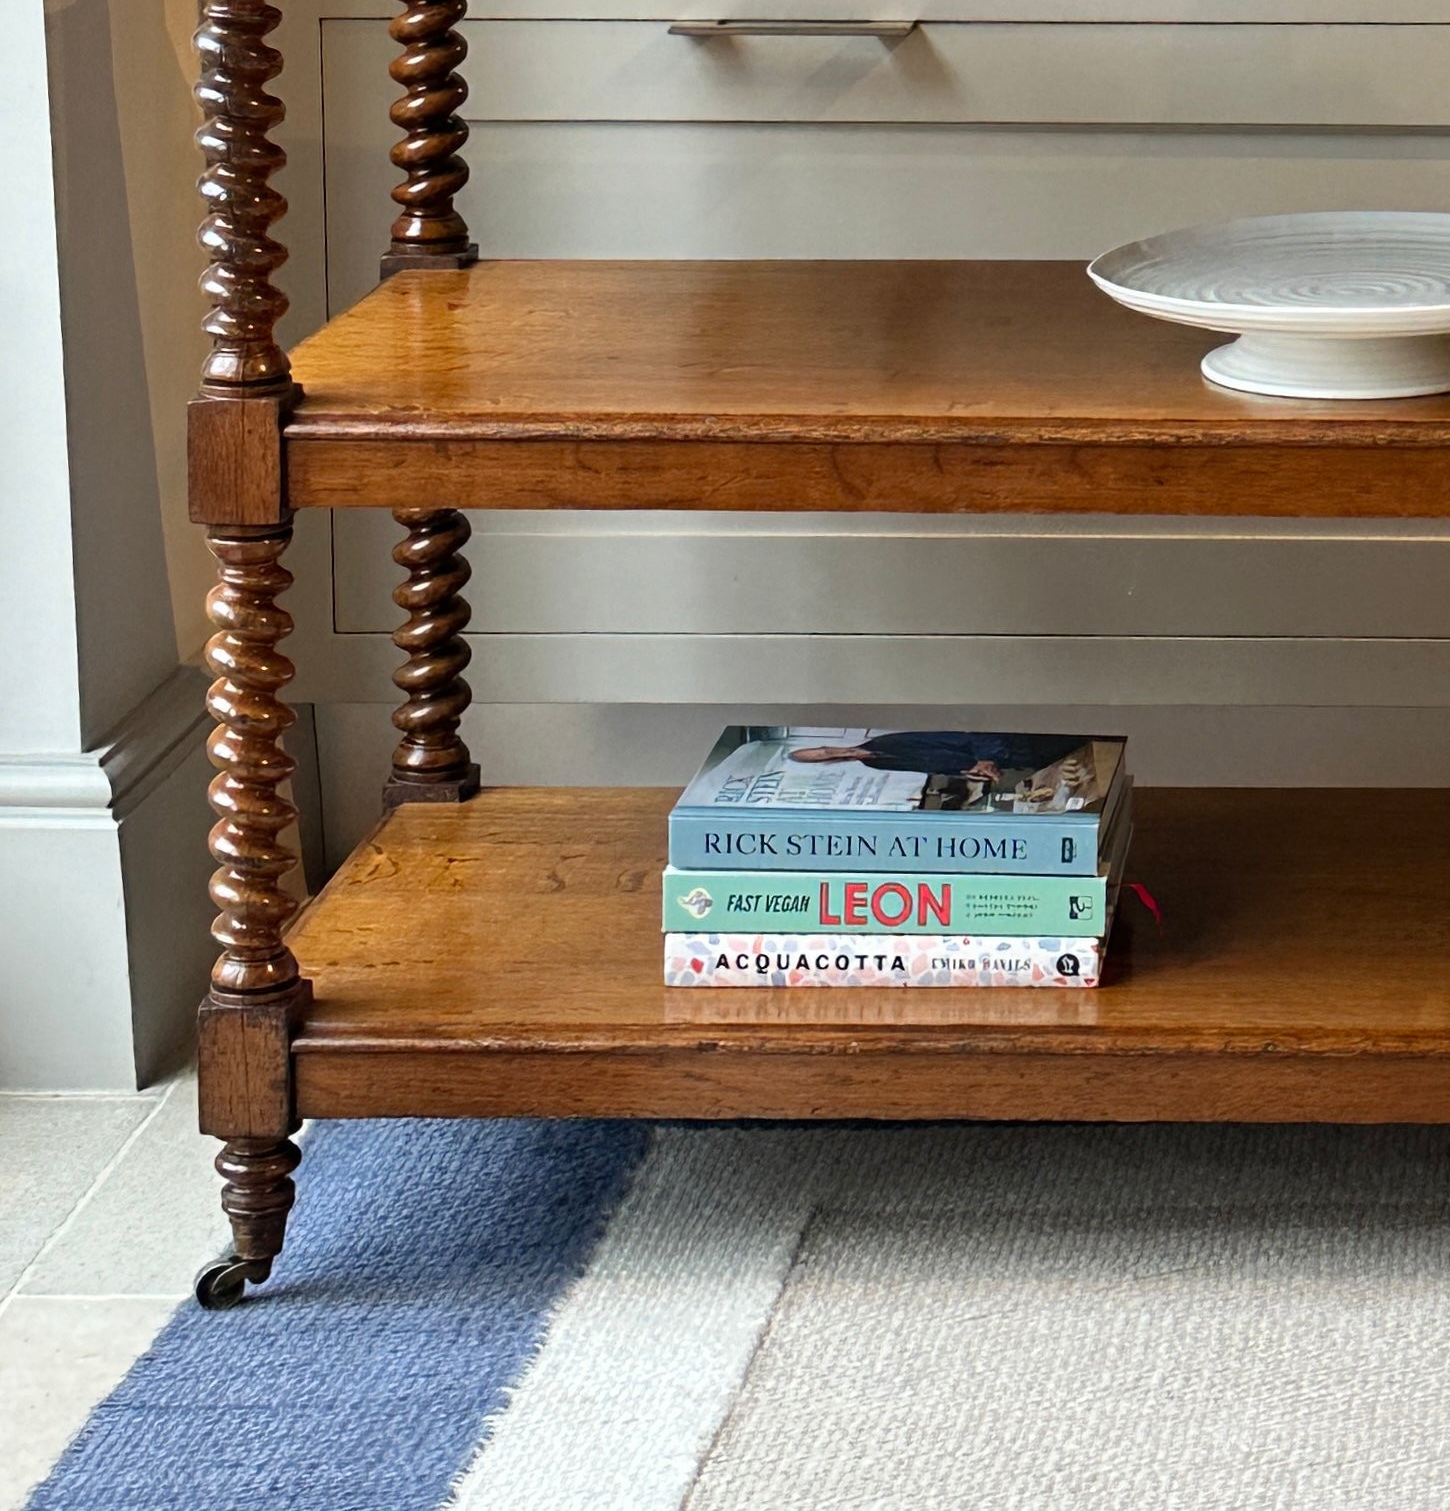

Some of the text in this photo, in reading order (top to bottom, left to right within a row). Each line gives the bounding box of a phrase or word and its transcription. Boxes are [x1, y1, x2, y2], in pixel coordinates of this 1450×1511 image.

[705, 833, 1027, 859] RICK STEIN AT HOME
[727, 895, 762, 913] FAST
[765, 895, 810, 913] VEGAN
[819, 882, 951, 926] LEON
[716, 953, 905, 974] ACQUACOTTA
